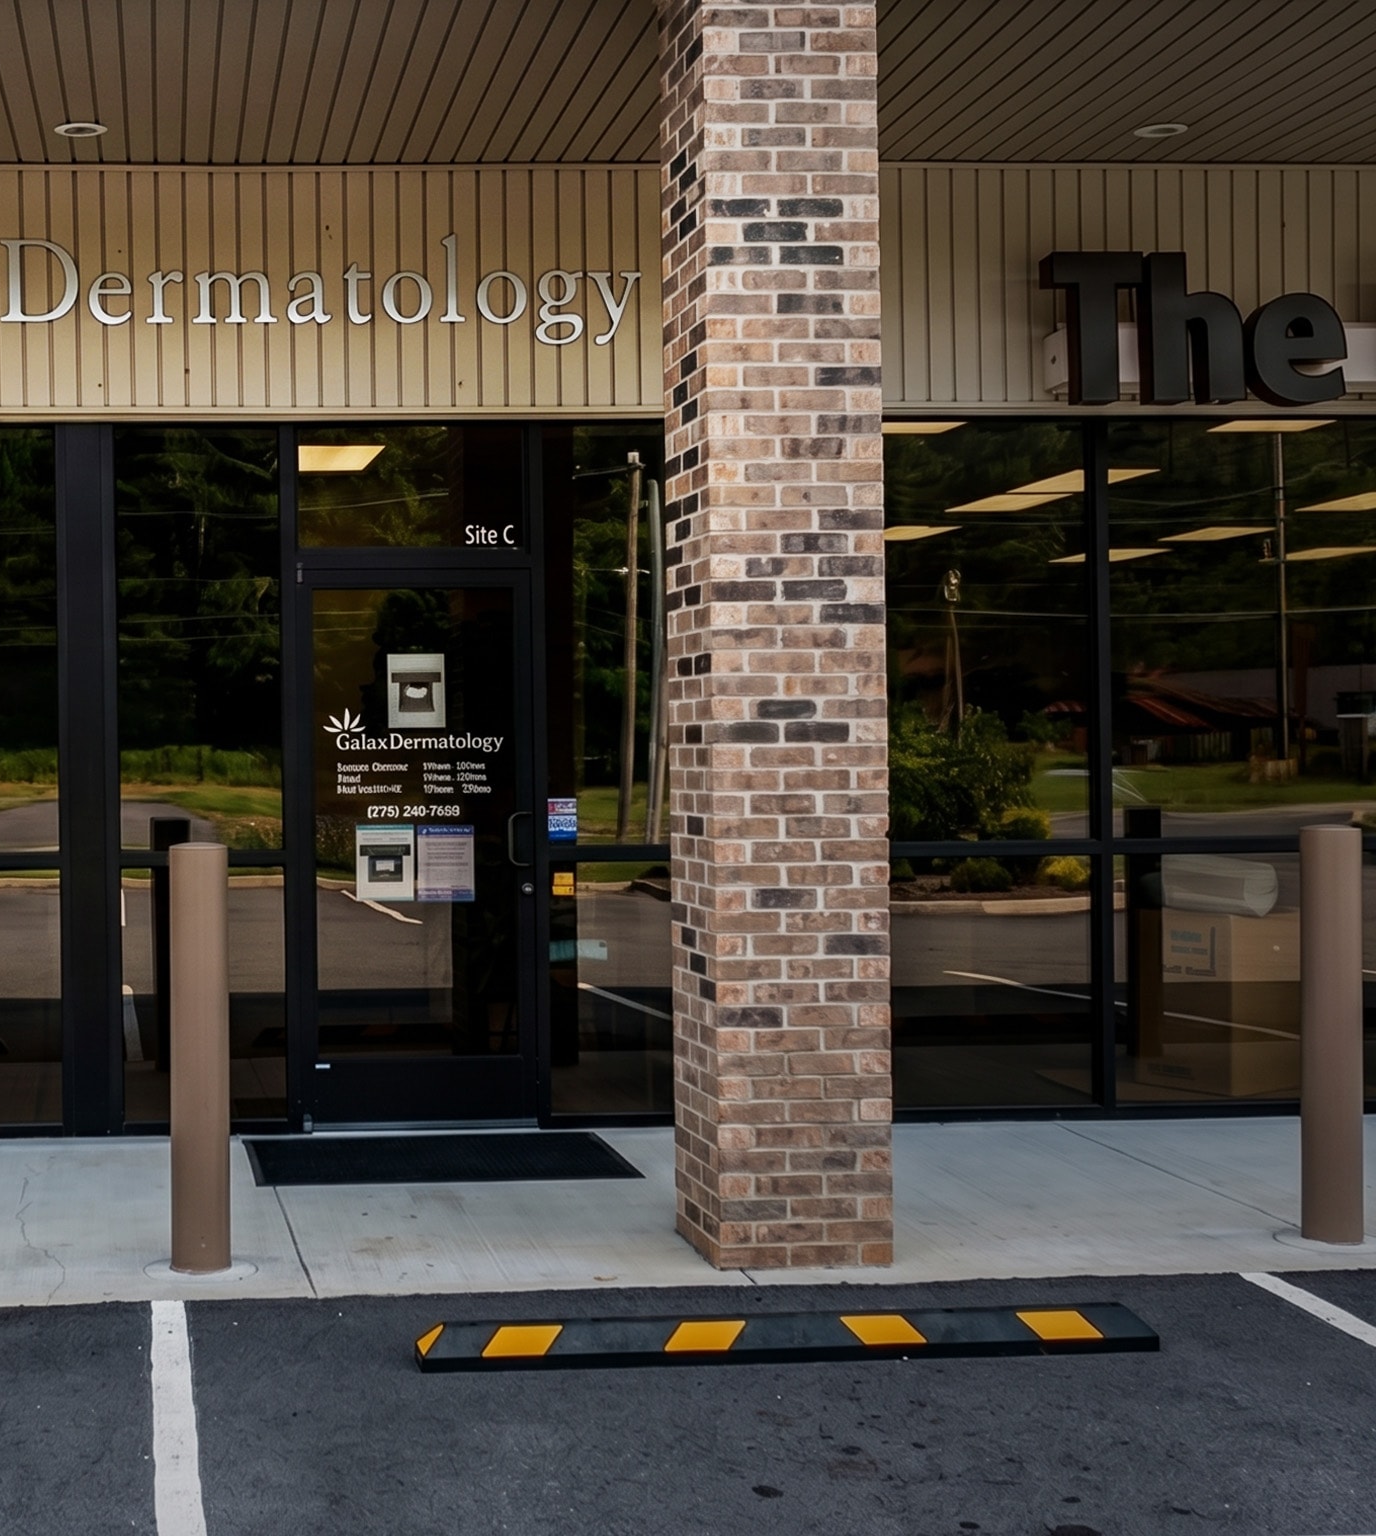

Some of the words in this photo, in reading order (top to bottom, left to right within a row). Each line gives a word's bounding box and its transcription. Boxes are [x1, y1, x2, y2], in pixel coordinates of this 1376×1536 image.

[1039, 251, 1348, 407] The
[465, 524, 498, 545] Site
[503, 524, 515, 545] C
[367, 805, 400, 819] (275)
